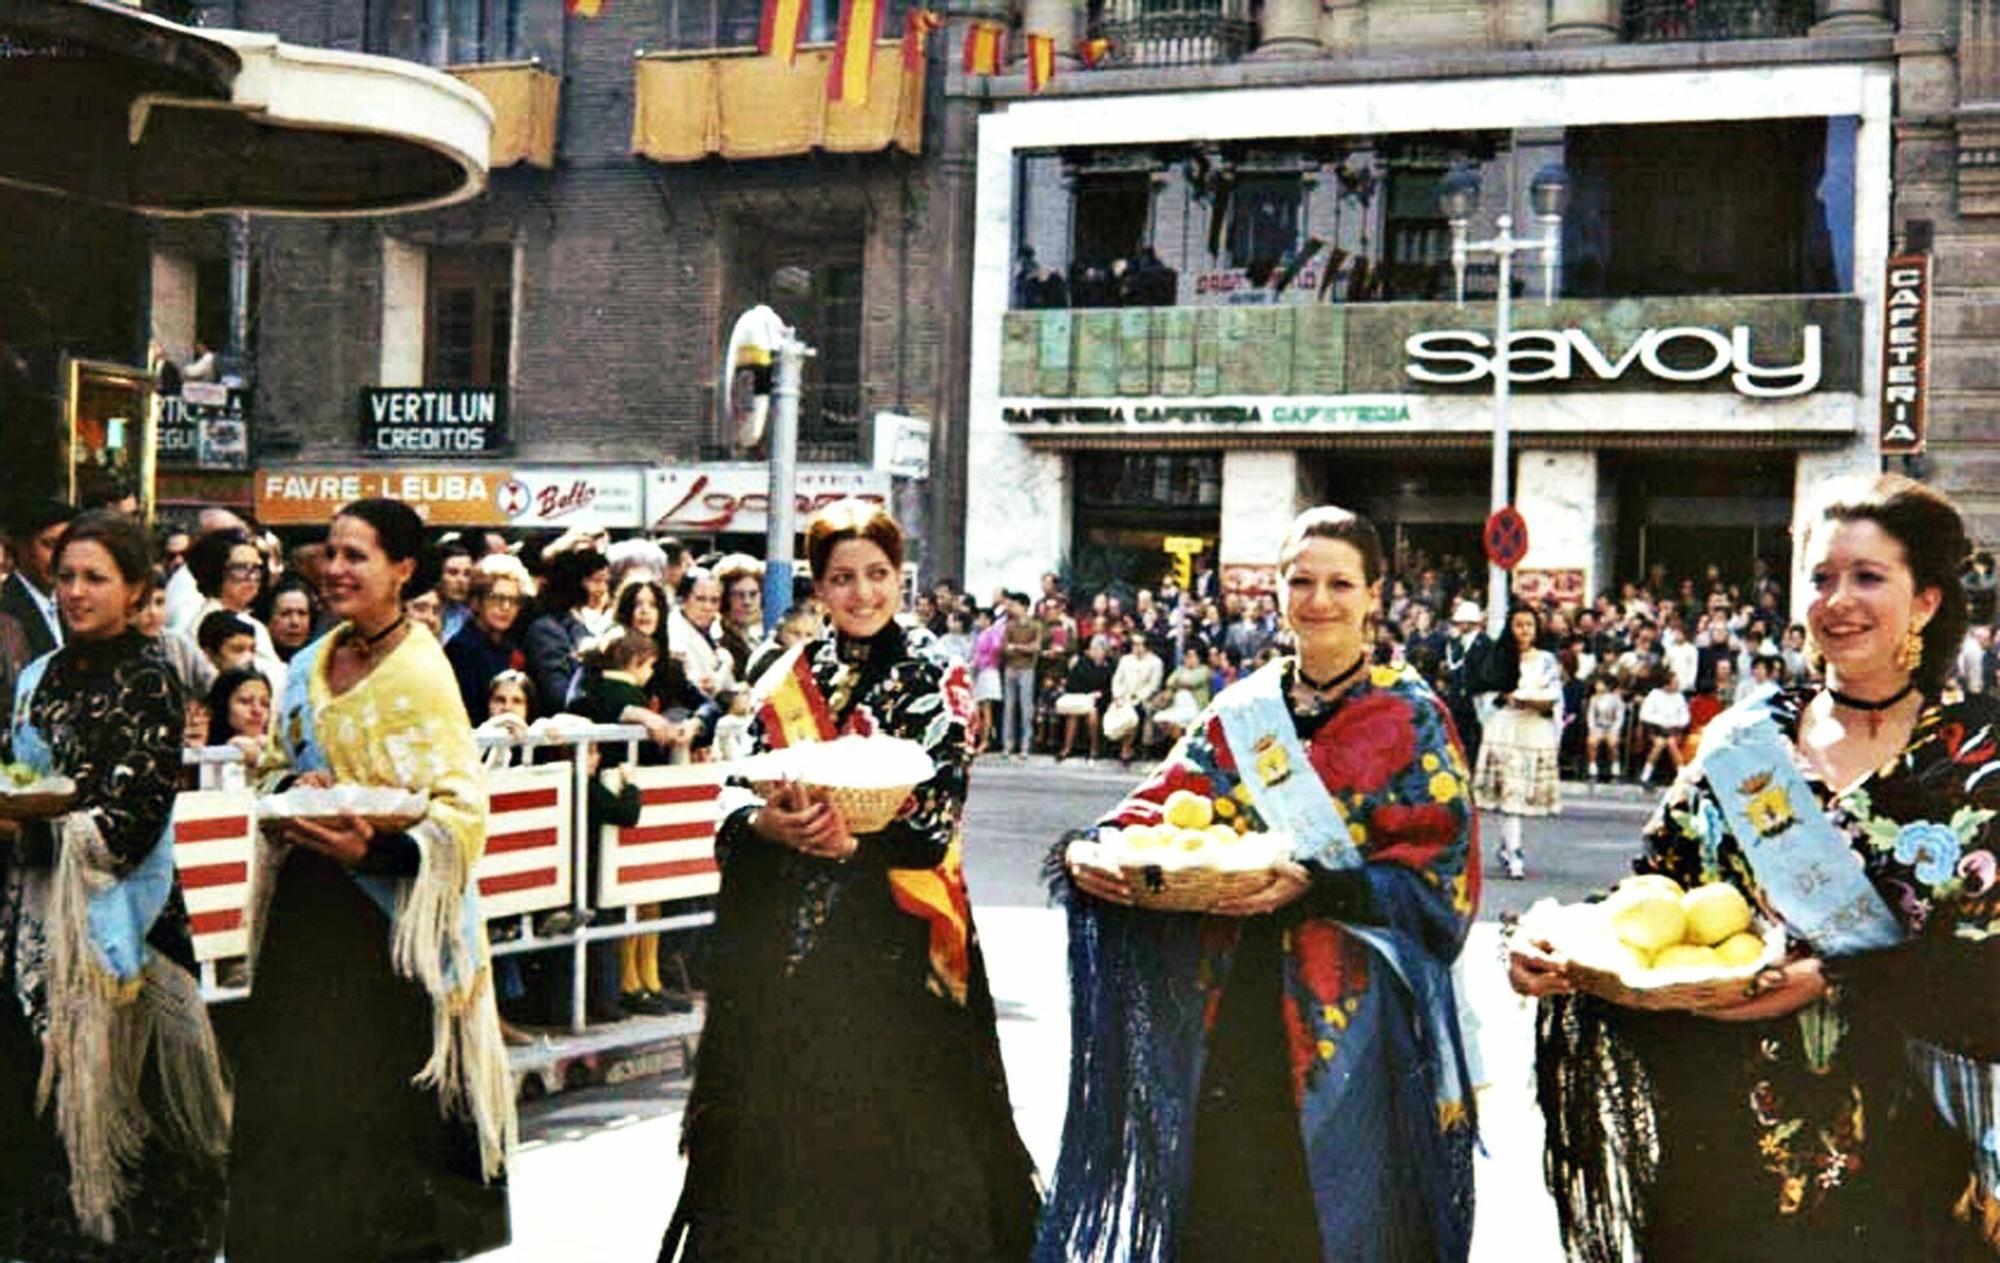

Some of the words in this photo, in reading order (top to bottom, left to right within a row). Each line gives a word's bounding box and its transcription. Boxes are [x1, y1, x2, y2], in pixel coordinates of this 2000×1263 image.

[1405, 324, 1822, 397] savoy
[1885, 269, 1920, 441] CAFETERIA
[371, 391, 496, 423] VERTILUN
[376, 427, 486, 450] CREDITOS
[265, 476, 362, 500] FAVRE
[381, 476, 488, 501] LEUBA
